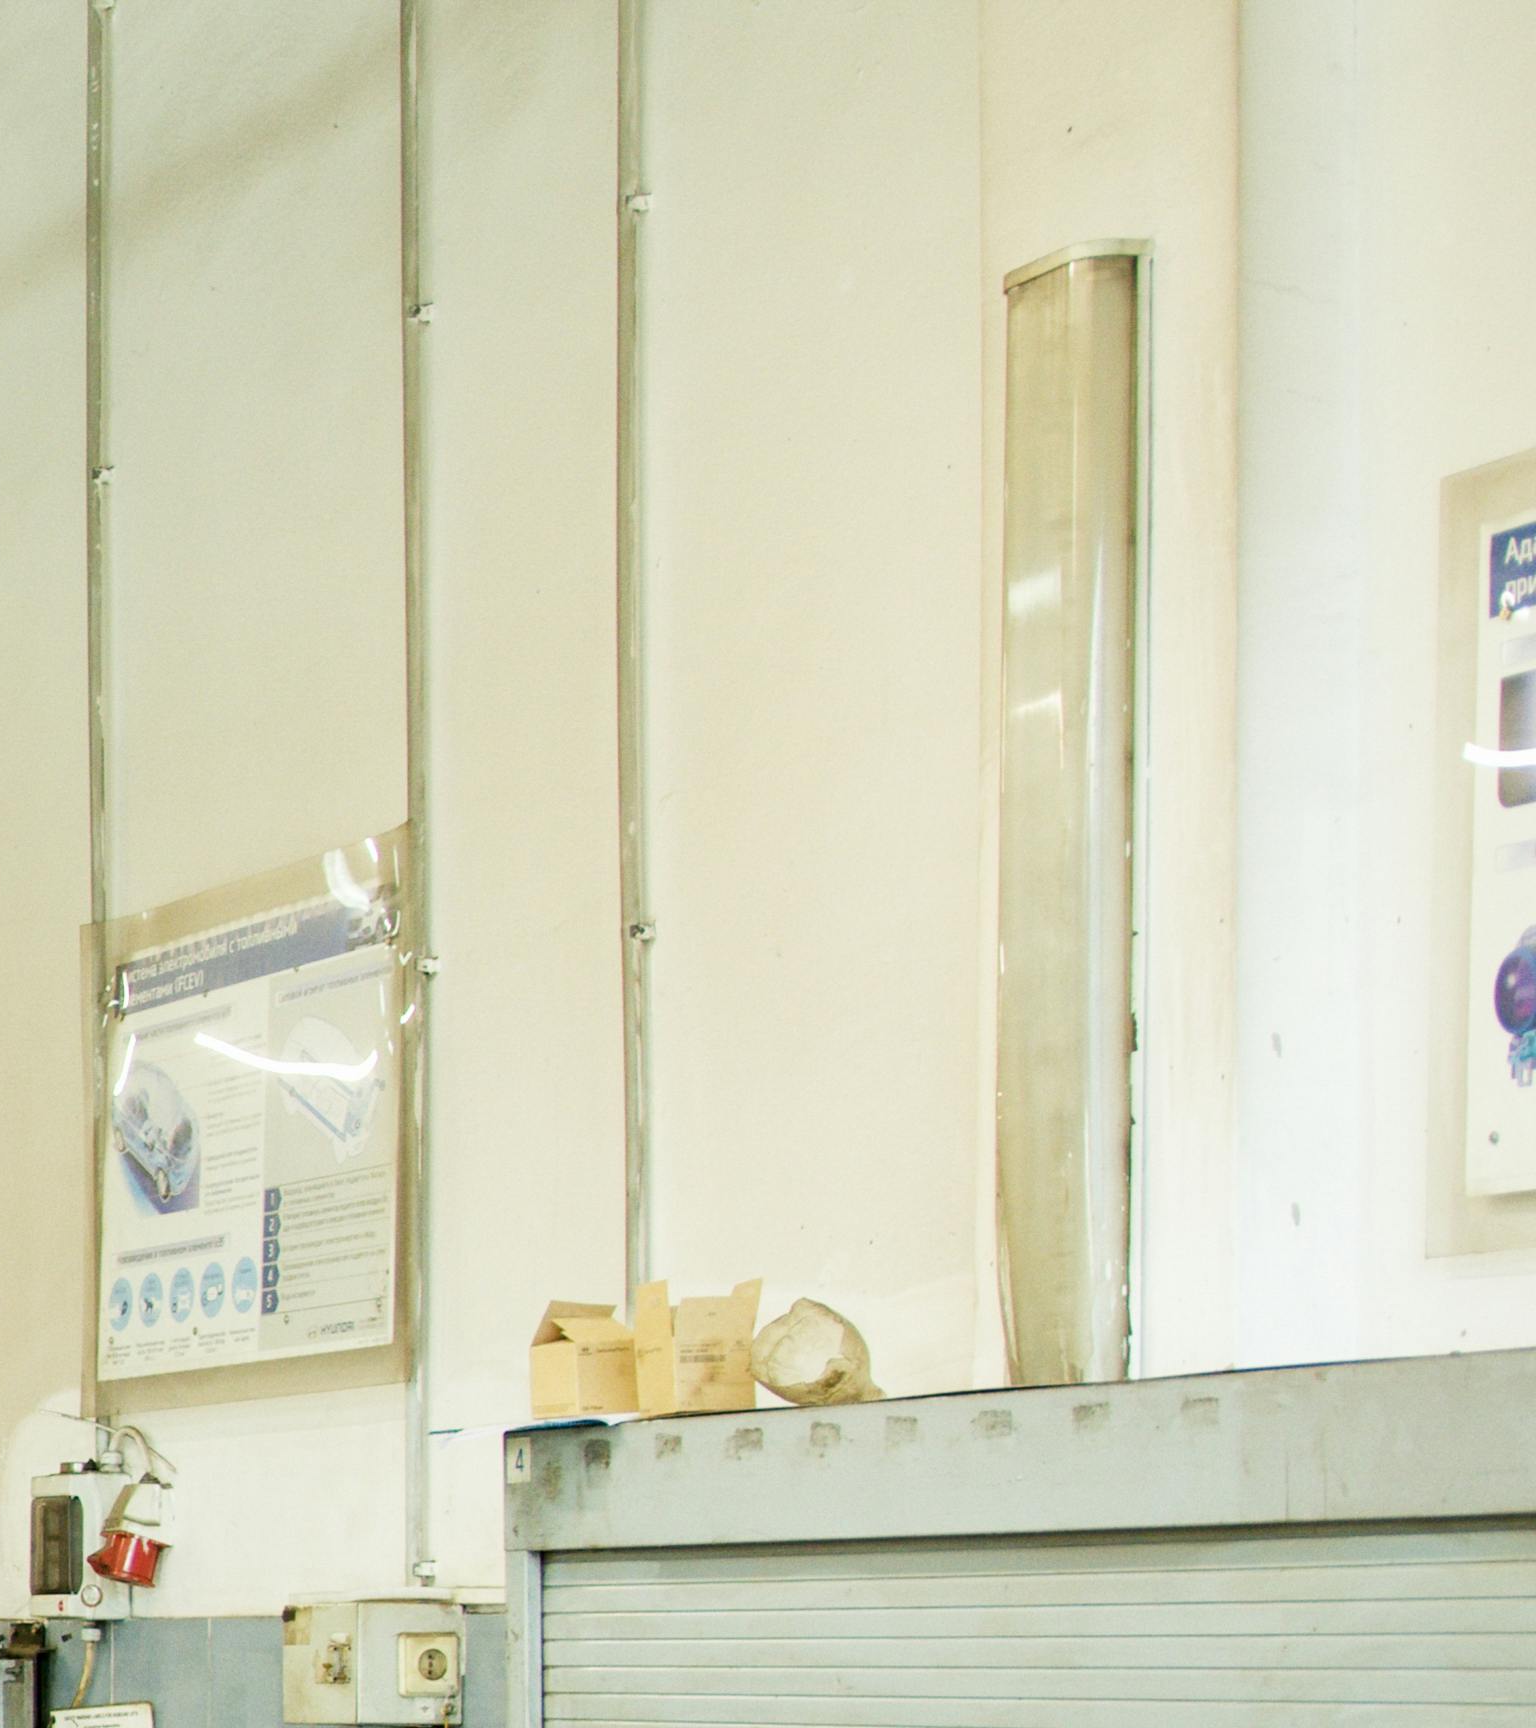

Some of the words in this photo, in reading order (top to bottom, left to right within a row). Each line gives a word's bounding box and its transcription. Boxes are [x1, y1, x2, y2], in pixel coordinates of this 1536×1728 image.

[1504, 534, 1536, 565] Ад
[268, 1218, 276, 1232] 2
[267, 1243, 275, 1258] 3
[266, 1268, 275, 1282] 4
[265, 1294, 273, 1309] 5
[515, 1448, 524, 1472] 4
